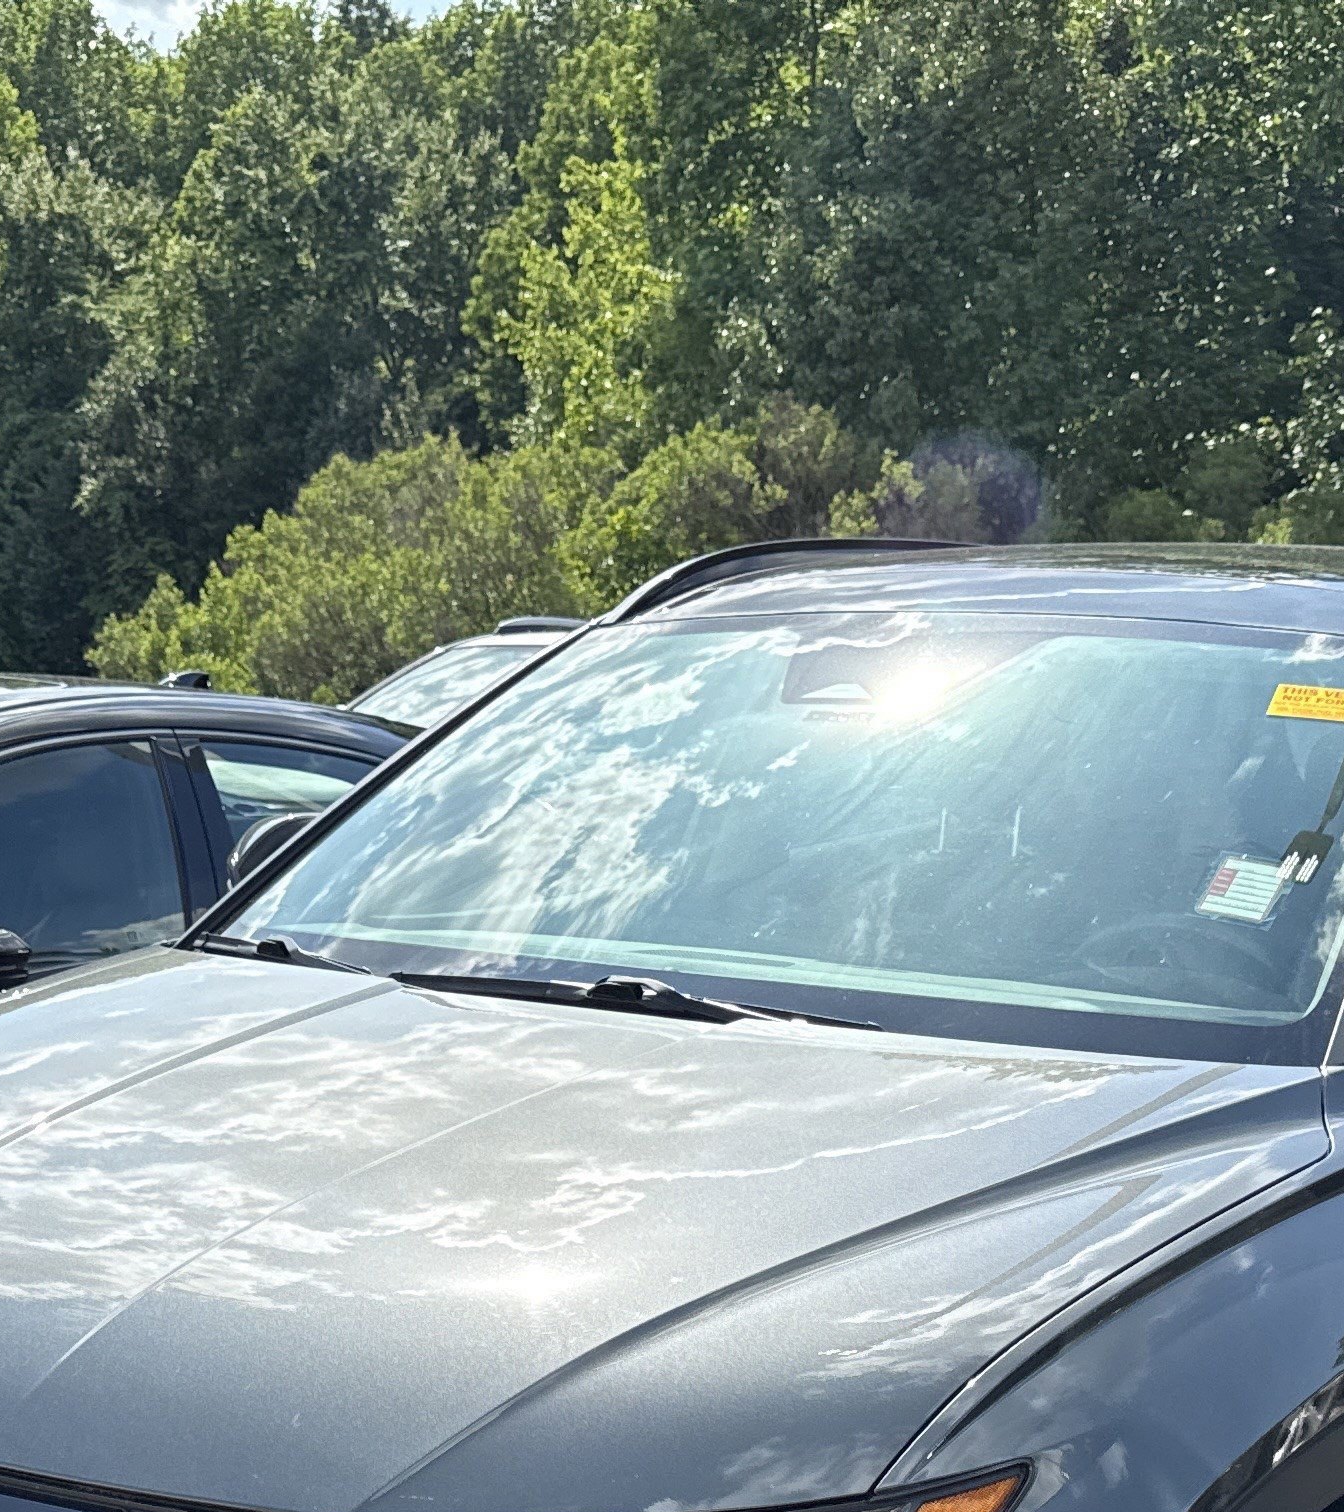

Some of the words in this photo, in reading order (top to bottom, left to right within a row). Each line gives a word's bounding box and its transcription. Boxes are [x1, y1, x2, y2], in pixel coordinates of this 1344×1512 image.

[1283, 686, 1318, 696] THIS
[1282, 694, 1310, 702] NOT
[1316, 697, 1344, 705] FOR
